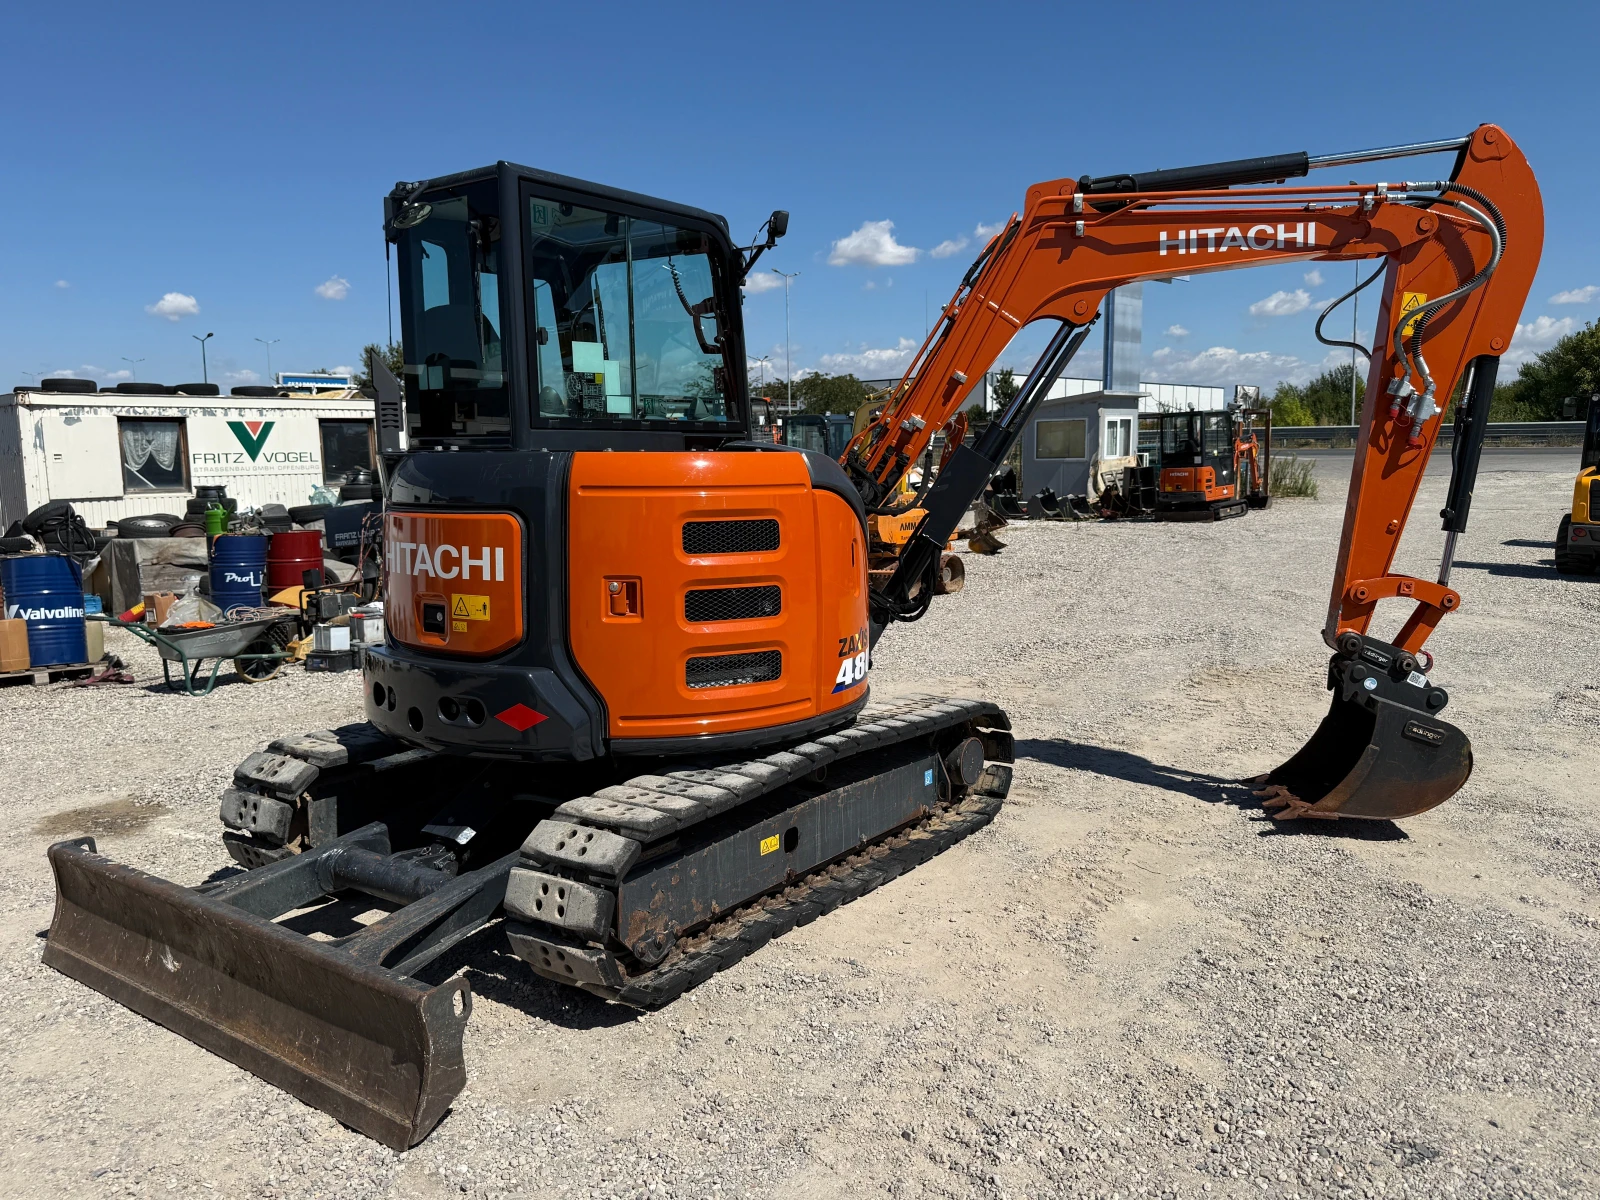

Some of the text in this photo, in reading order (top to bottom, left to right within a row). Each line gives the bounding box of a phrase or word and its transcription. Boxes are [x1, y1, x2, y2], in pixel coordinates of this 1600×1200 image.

[1159, 221, 1316, 256] HITACHI
[192, 451, 319, 464] FRITZ VOGEL
[335, 531, 357, 540] FRANZ
[384, 540, 504, 582] HITACHI
[19, 606, 84, 621] Valvoline
